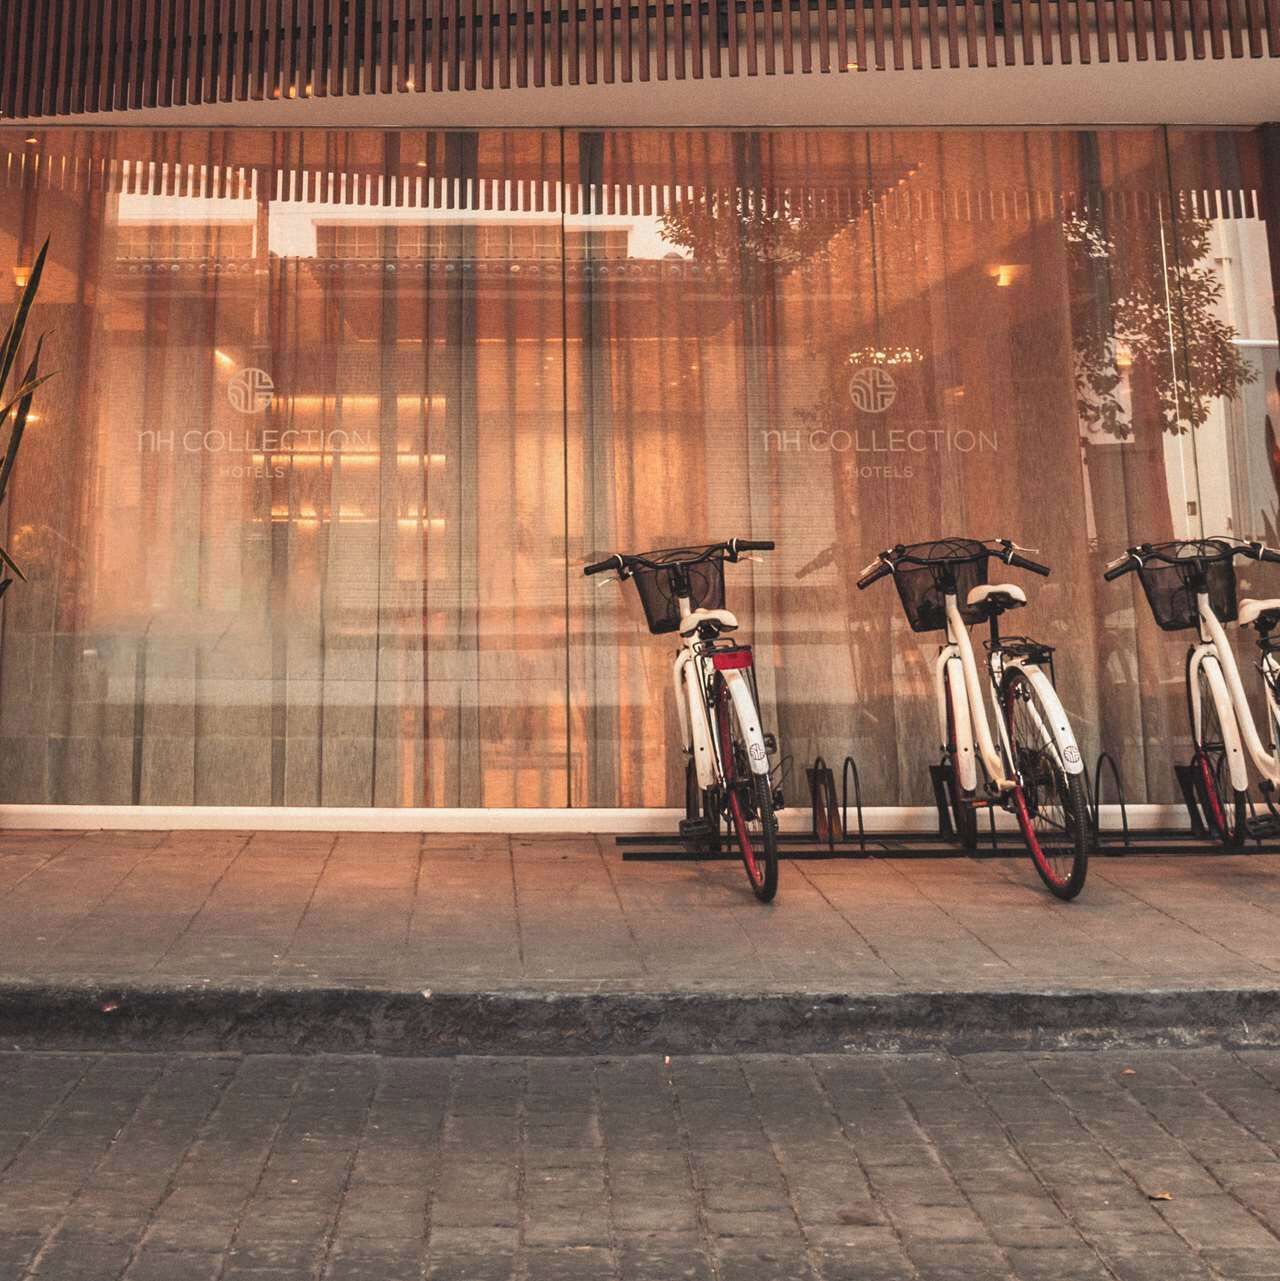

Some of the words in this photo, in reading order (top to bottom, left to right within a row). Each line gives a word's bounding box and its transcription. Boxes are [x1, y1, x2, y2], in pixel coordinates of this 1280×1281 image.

[183, 430, 371, 452] COLLECTION
[809, 430, 999, 452] COLLECTION
[219, 466, 285, 479] HOTELS
[847, 466, 914, 479] HOTELS
